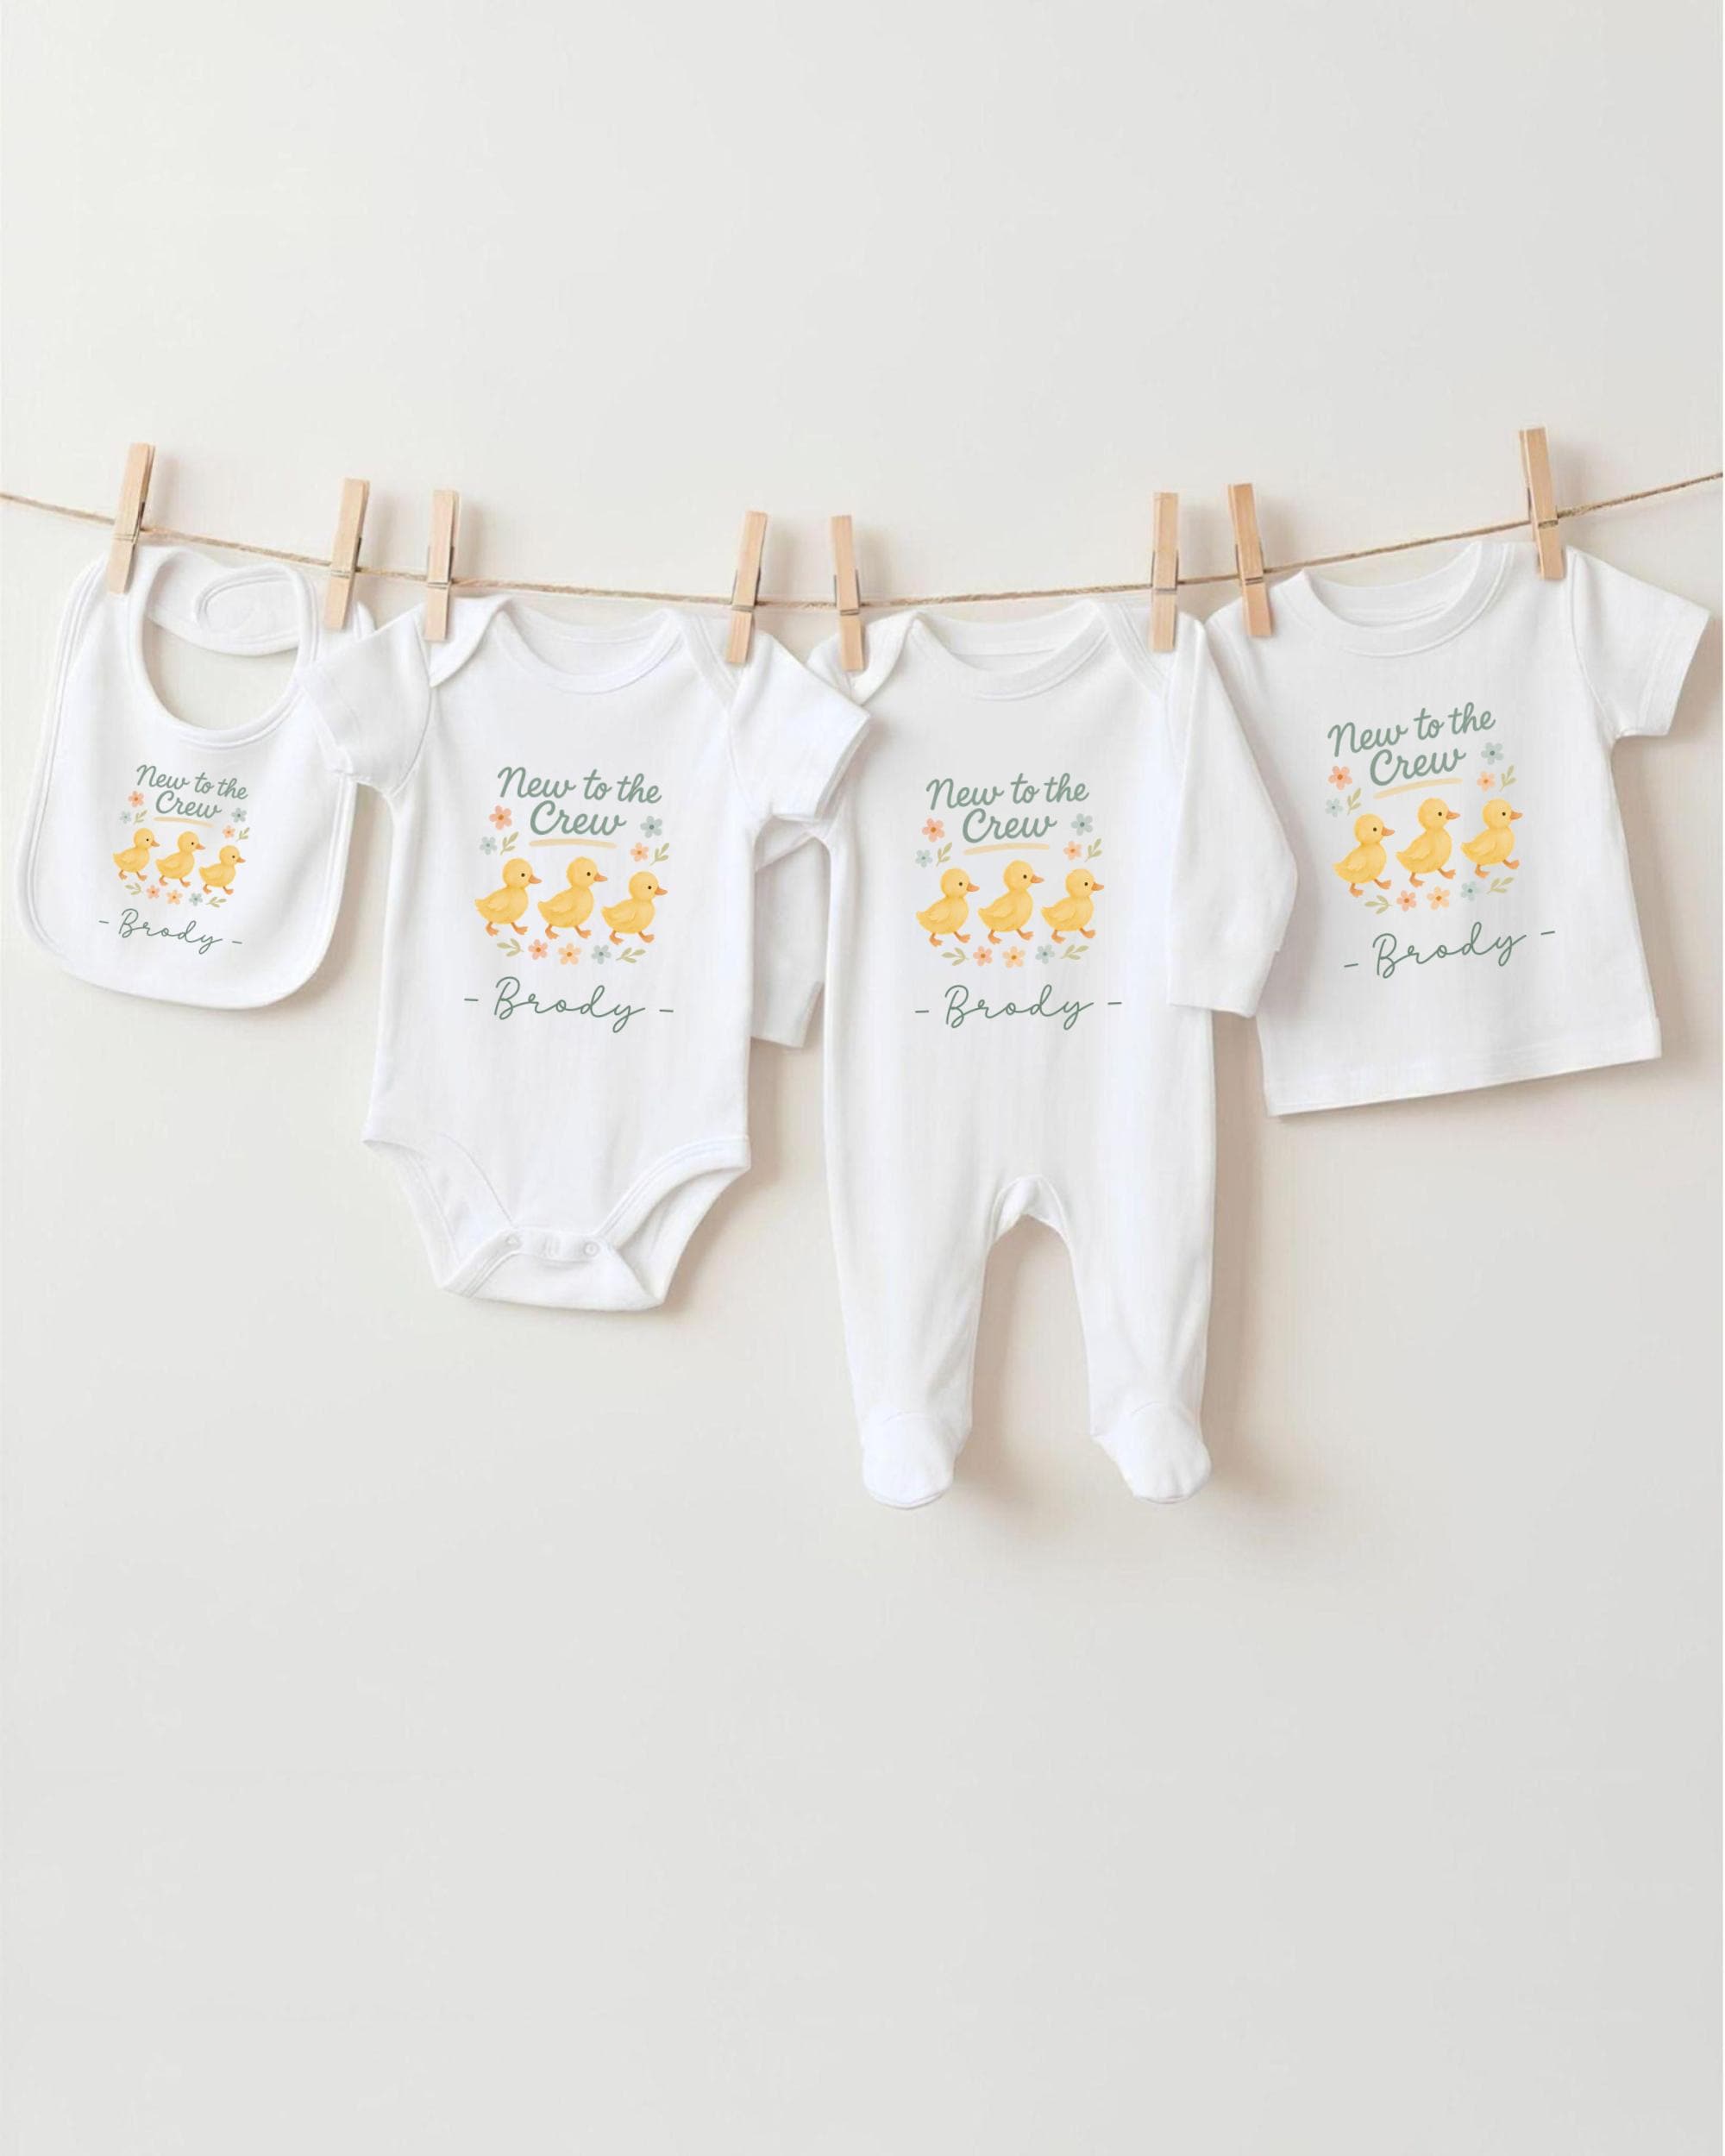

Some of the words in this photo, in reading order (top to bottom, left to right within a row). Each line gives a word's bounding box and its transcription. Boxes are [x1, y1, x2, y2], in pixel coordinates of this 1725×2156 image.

[1327, 722, 1408, 757] New
[1414, 707, 1445, 740] to
[1448, 701, 1496, 733] the
[136, 764, 189, 790] New
[195, 772, 215, 793] to
[216, 777, 248, 800] the
[497, 767, 576, 799] New
[583, 768, 612, 801] to
[618, 773, 662, 804] the
[1370, 748, 1466, 787] Crew
[155, 790, 222, 818] Crew
[925, 778, 1004, 810] New
[1011, 774, 1039, 804] to
[1044, 772, 1089, 801] the
[530, 800, 627, 837] Crew
[962, 808, 1057, 843] Crew
[118, 908, 223, 955] Brody
[1372, 920, 1527, 980] Brody
[492, 975, 646, 1033] Brody
[944, 984, 1095, 1031] Brody
